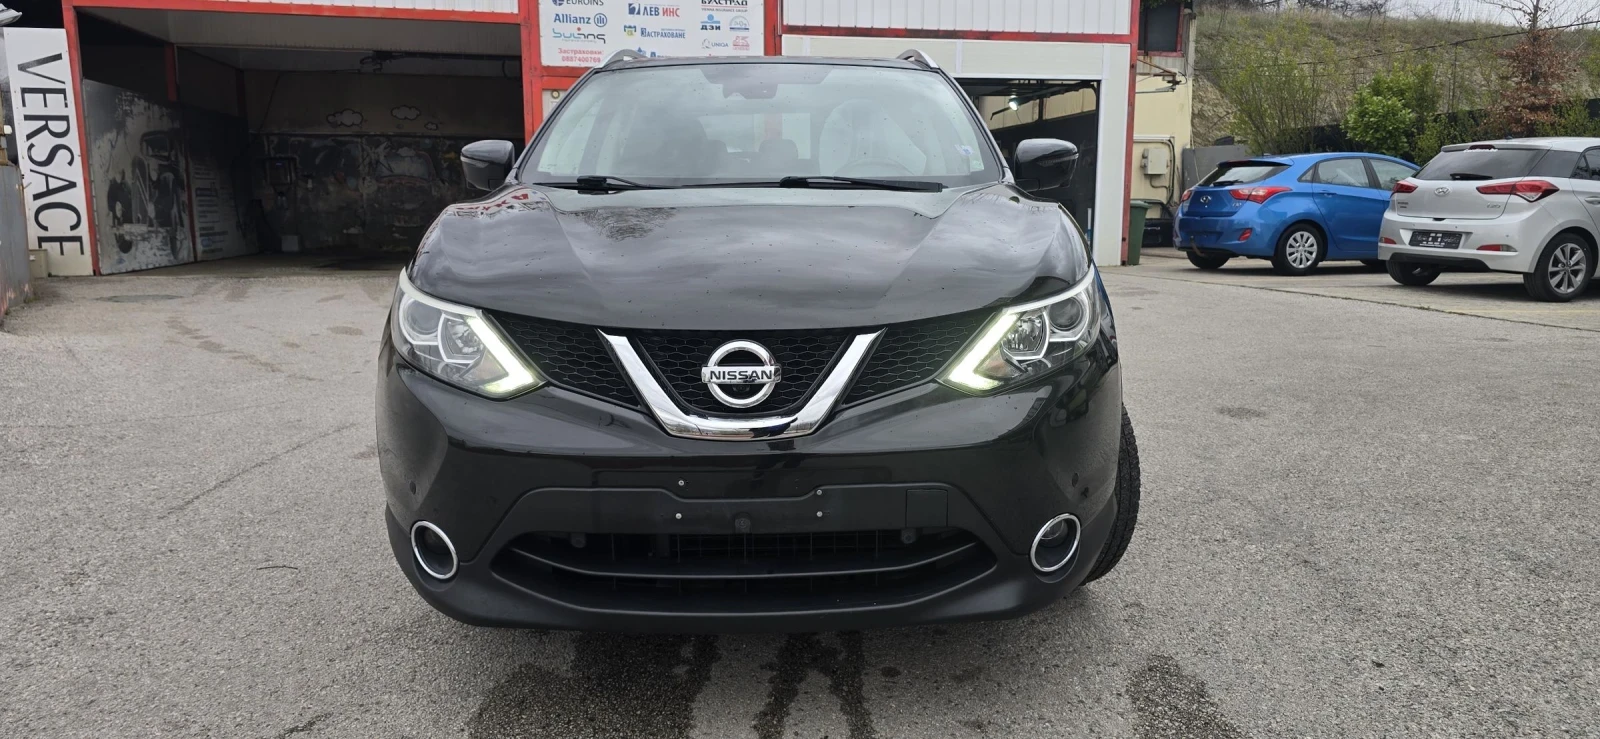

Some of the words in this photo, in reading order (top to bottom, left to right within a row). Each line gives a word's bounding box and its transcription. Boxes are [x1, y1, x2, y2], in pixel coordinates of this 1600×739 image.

[642, 6, 660, 16] ЛЕВ
[662, 7, 680, 17] ИНС
[553, 13, 591, 24] Allianz
[17, 52, 85, 256] VERSACE
[710, 370, 773, 380] NISSAN
